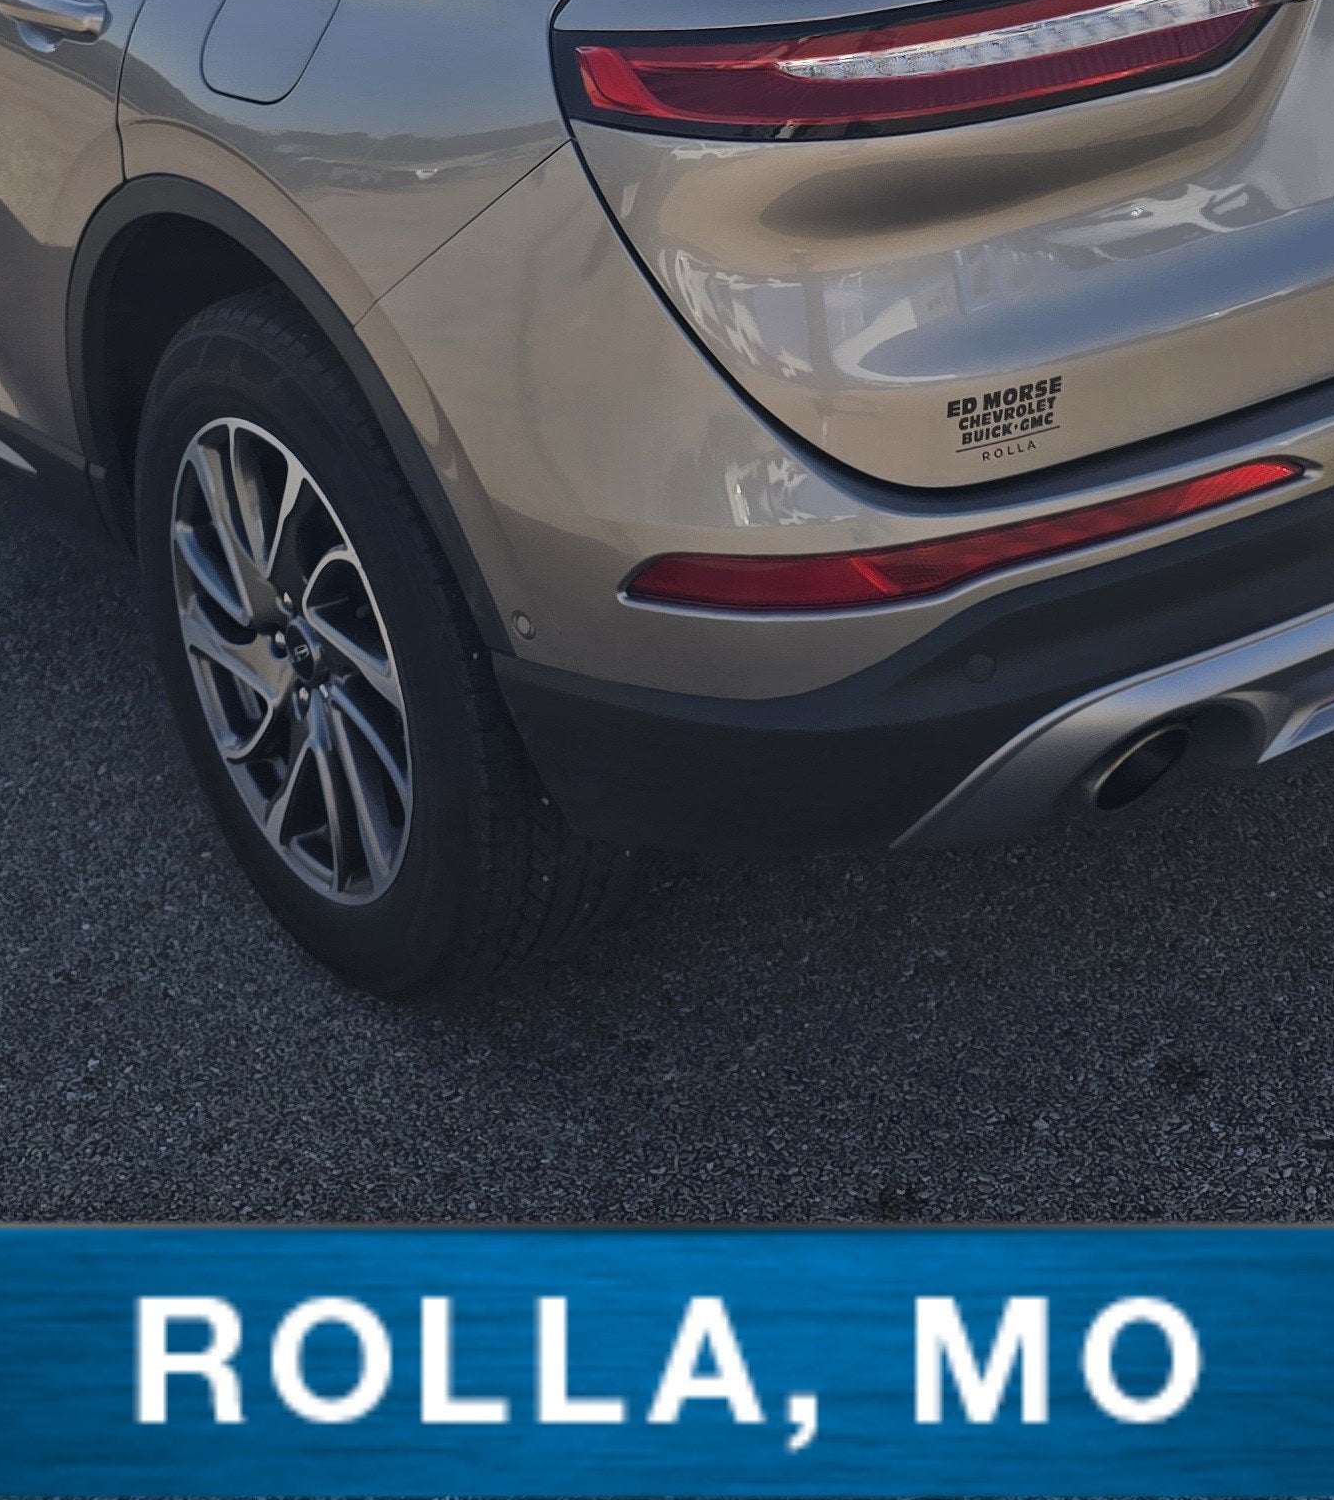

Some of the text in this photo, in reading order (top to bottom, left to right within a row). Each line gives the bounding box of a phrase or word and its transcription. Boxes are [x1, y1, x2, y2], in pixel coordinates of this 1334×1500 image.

[946, 375, 1063, 419] ED MORSE
[957, 395, 1057, 432] CHEVROLET
[981, 439, 1037, 461] ROLLA
